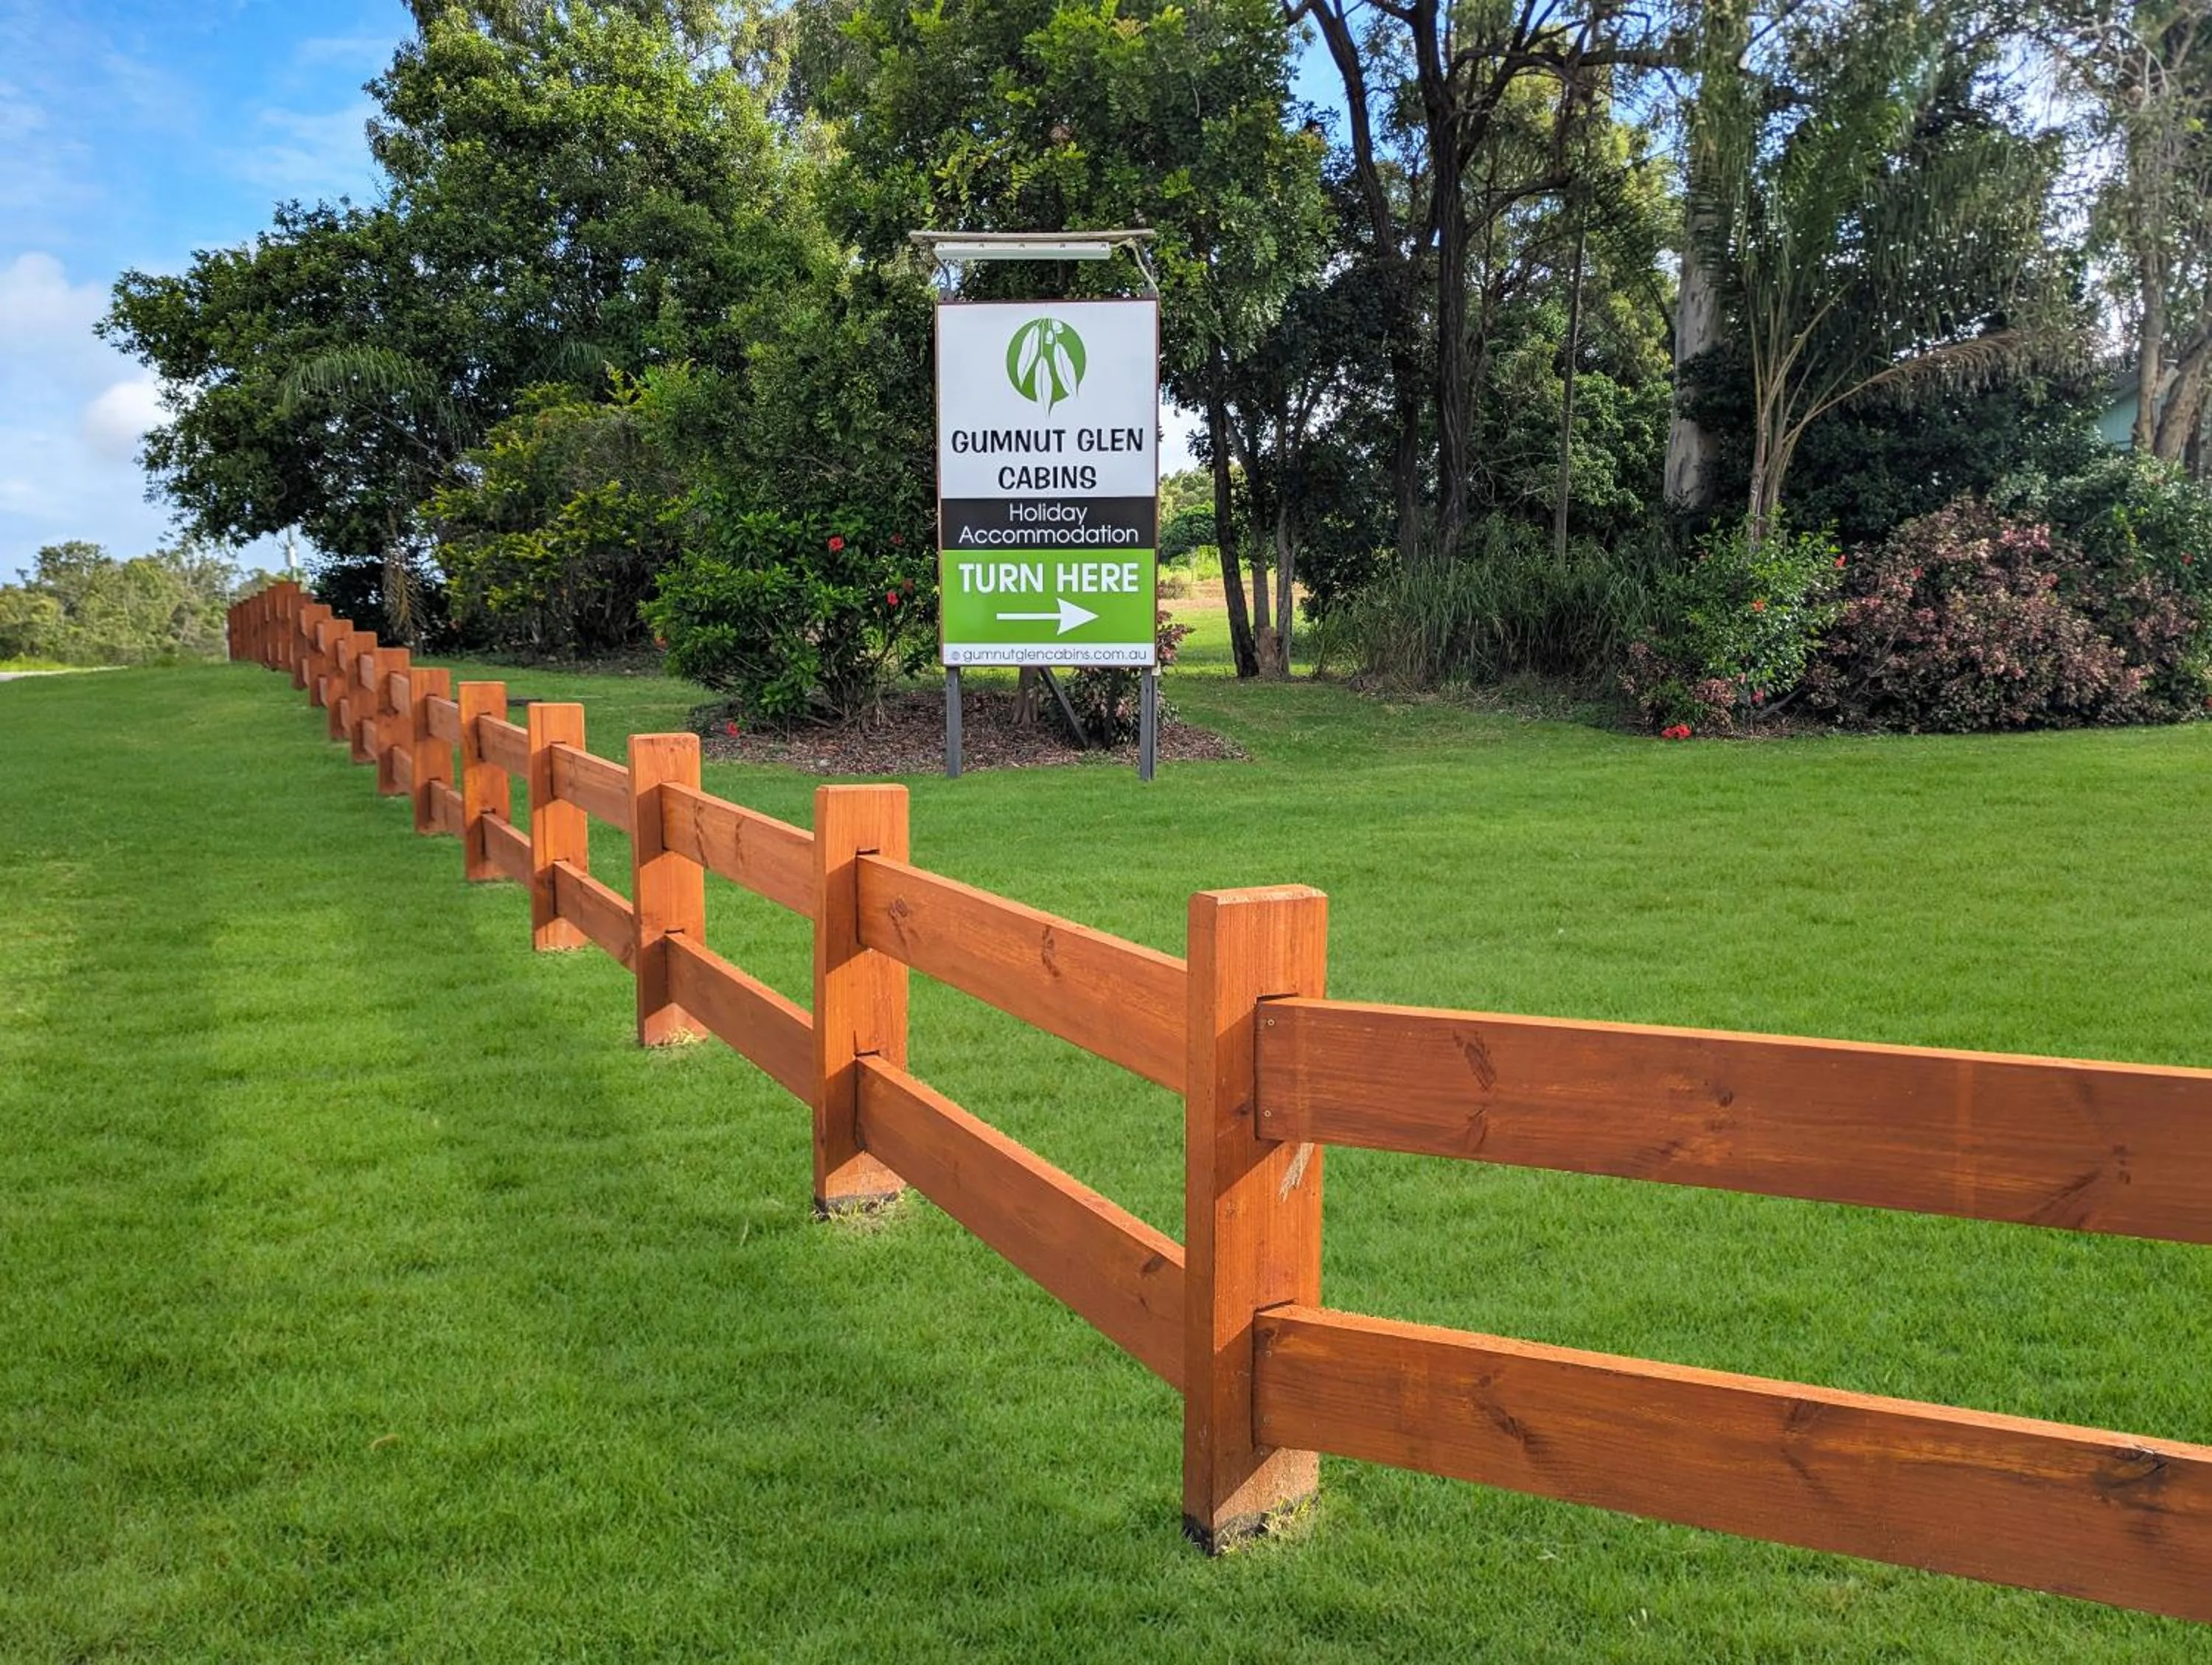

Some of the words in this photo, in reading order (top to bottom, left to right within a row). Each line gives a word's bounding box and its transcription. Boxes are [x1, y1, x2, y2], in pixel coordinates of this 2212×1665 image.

[952, 429, 1066, 453] GUMNUT
[1077, 428, 1144, 451] GLEN
[998, 465, 1096, 490] CABINS
[1009, 503, 1088, 525] Holiday
[959, 525, 1139, 543] Accommodation
[959, 563, 1043, 593] TURN
[1057, 563, 1139, 592] HERE
[963, 648, 1147, 662] gumnutglencabins.com.au
